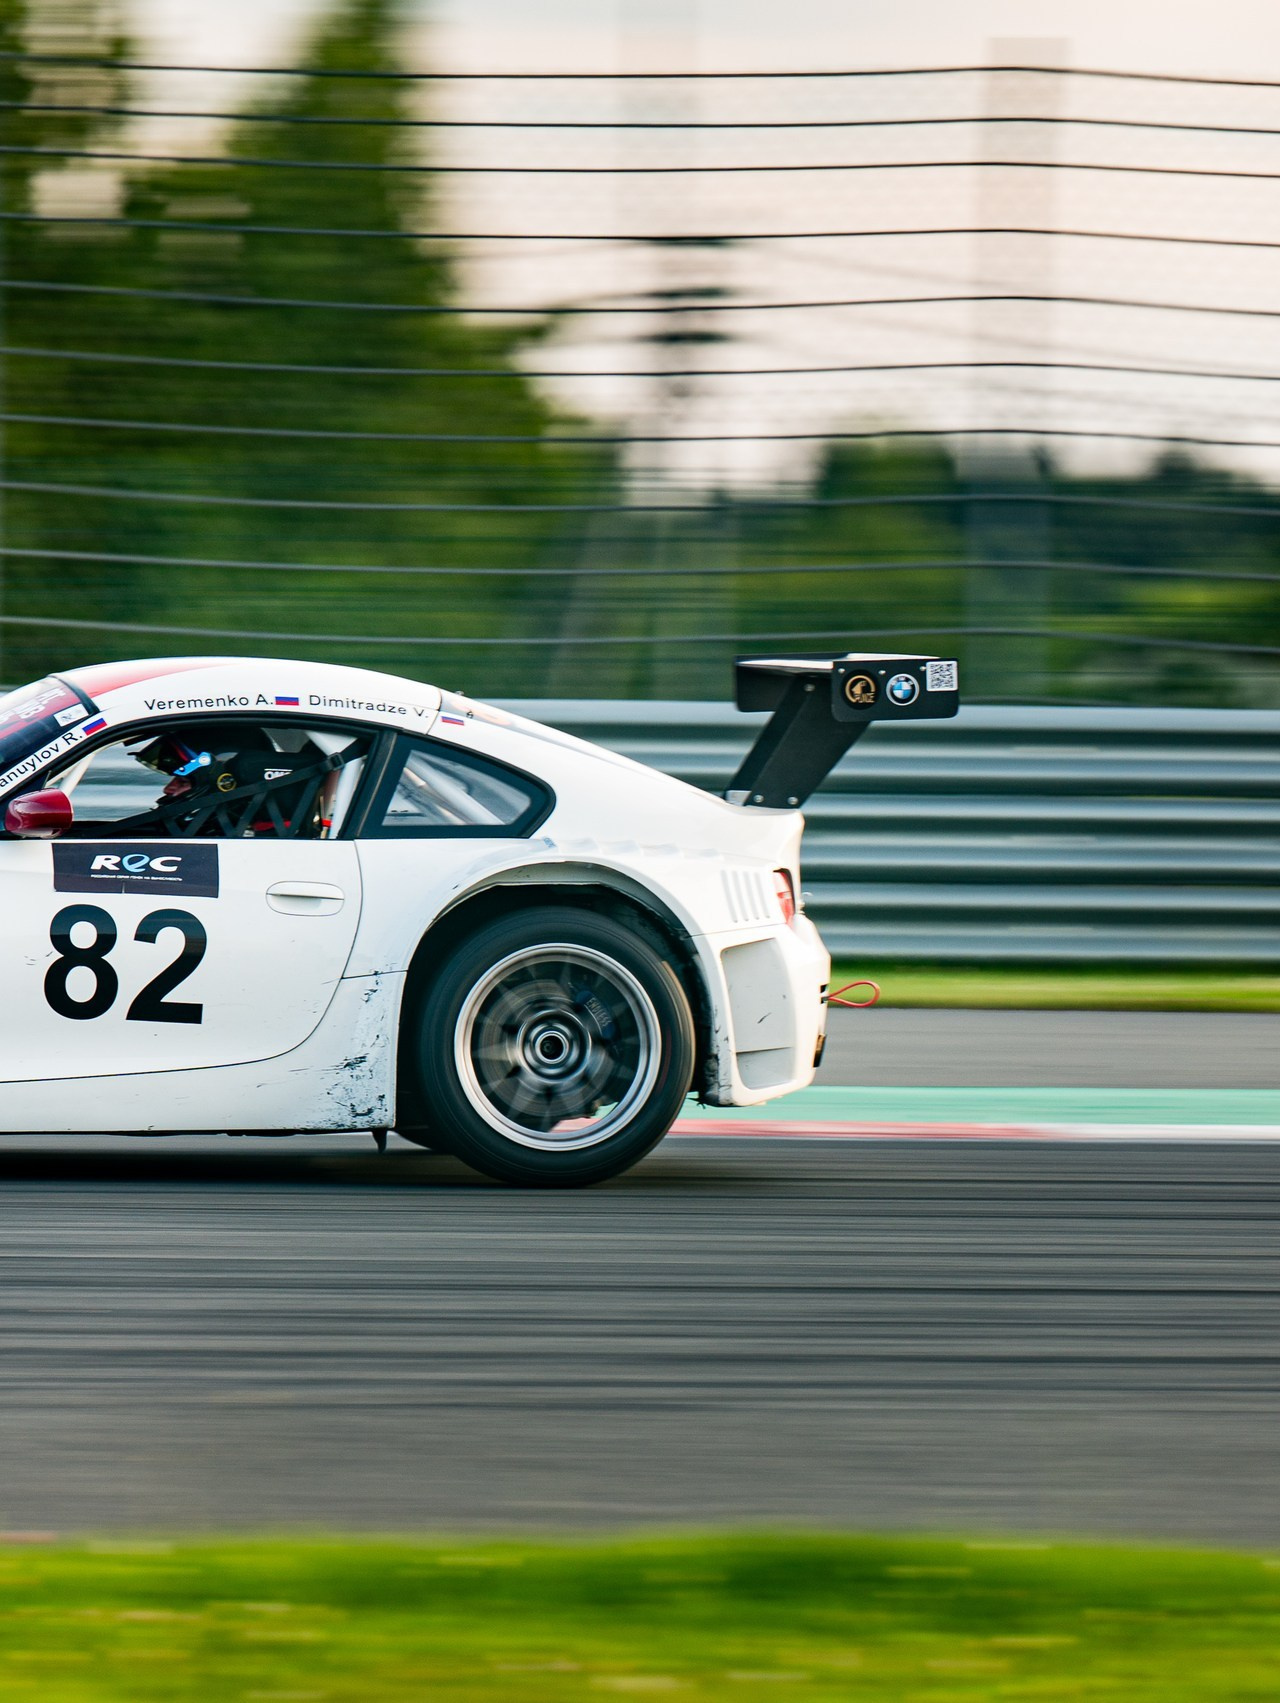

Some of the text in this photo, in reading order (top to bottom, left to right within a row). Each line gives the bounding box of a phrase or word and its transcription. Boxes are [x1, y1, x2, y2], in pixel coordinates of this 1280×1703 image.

[144, 693, 274, 710] Veremenko A.
[308, 694, 429, 719] Dimitradze V.
[61, 731, 83, 746] R.
[43, 903, 208, 1025] 82
